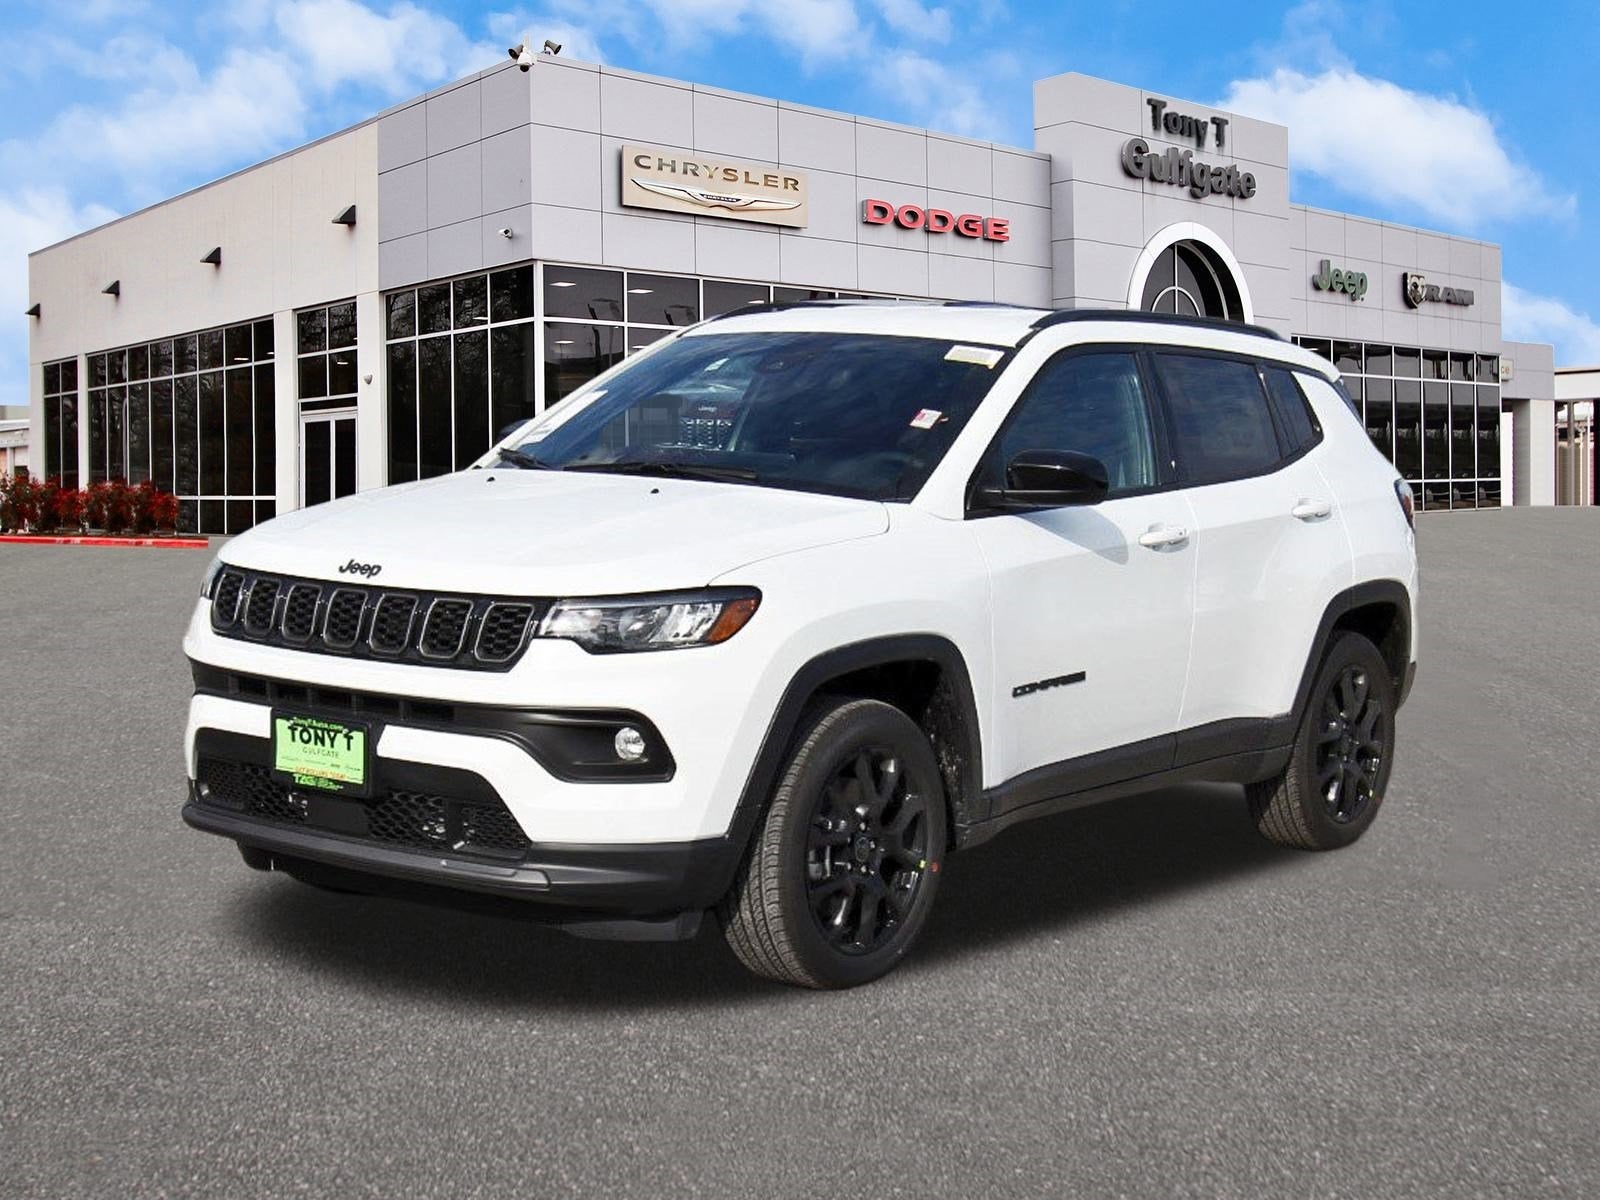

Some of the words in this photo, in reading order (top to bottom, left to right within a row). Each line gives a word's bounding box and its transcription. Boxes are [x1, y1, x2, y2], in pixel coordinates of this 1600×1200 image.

[1147, 98, 1208, 148] Tony
[1211, 116, 1229, 147] T
[633, 154, 800, 192] CHRYSLER
[1121, 137, 1257, 199] Gulfgate
[862, 198, 1010, 242] DODGE
[1312, 259, 1368, 302] Jeep
[1425, 283, 1475, 306] RAM
[338, 558, 382, 579] Jeep
[288, 725, 338, 749] TONY
[343, 733, 354, 752] T
